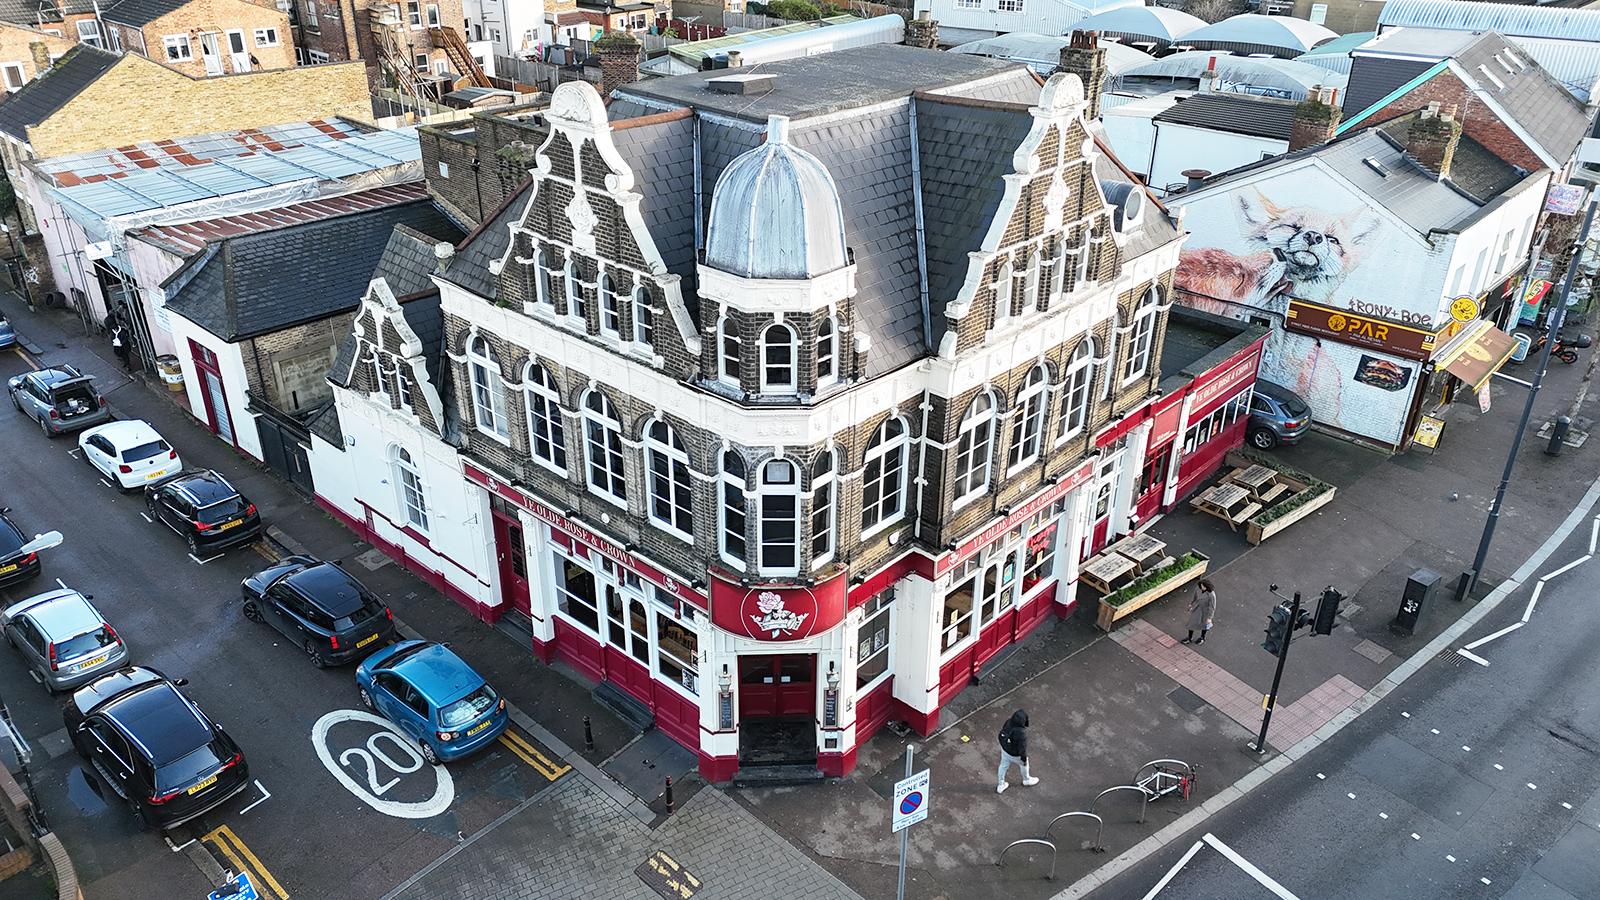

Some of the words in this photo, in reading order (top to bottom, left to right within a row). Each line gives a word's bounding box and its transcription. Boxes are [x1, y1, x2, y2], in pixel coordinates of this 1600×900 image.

[1348, 319, 1389, 341] PAR
[1424, 335, 1433, 343] 57
[986, 521, 1008, 541] OLDE
[1009, 508, 1029, 525] ROSE
[1037, 484, 1062, 506] CROWN
[522, 496, 536, 510] YE
[537, 505, 562, 525] OLDE
[564, 519, 588, 541] ROSE
[590, 535, 598, 547] &
[600, 540, 636, 568] CROWN
[339, 731, 424, 796] 20
[896, 784, 918, 798] ZONE
[897, 772, 928, 789] Controlled
